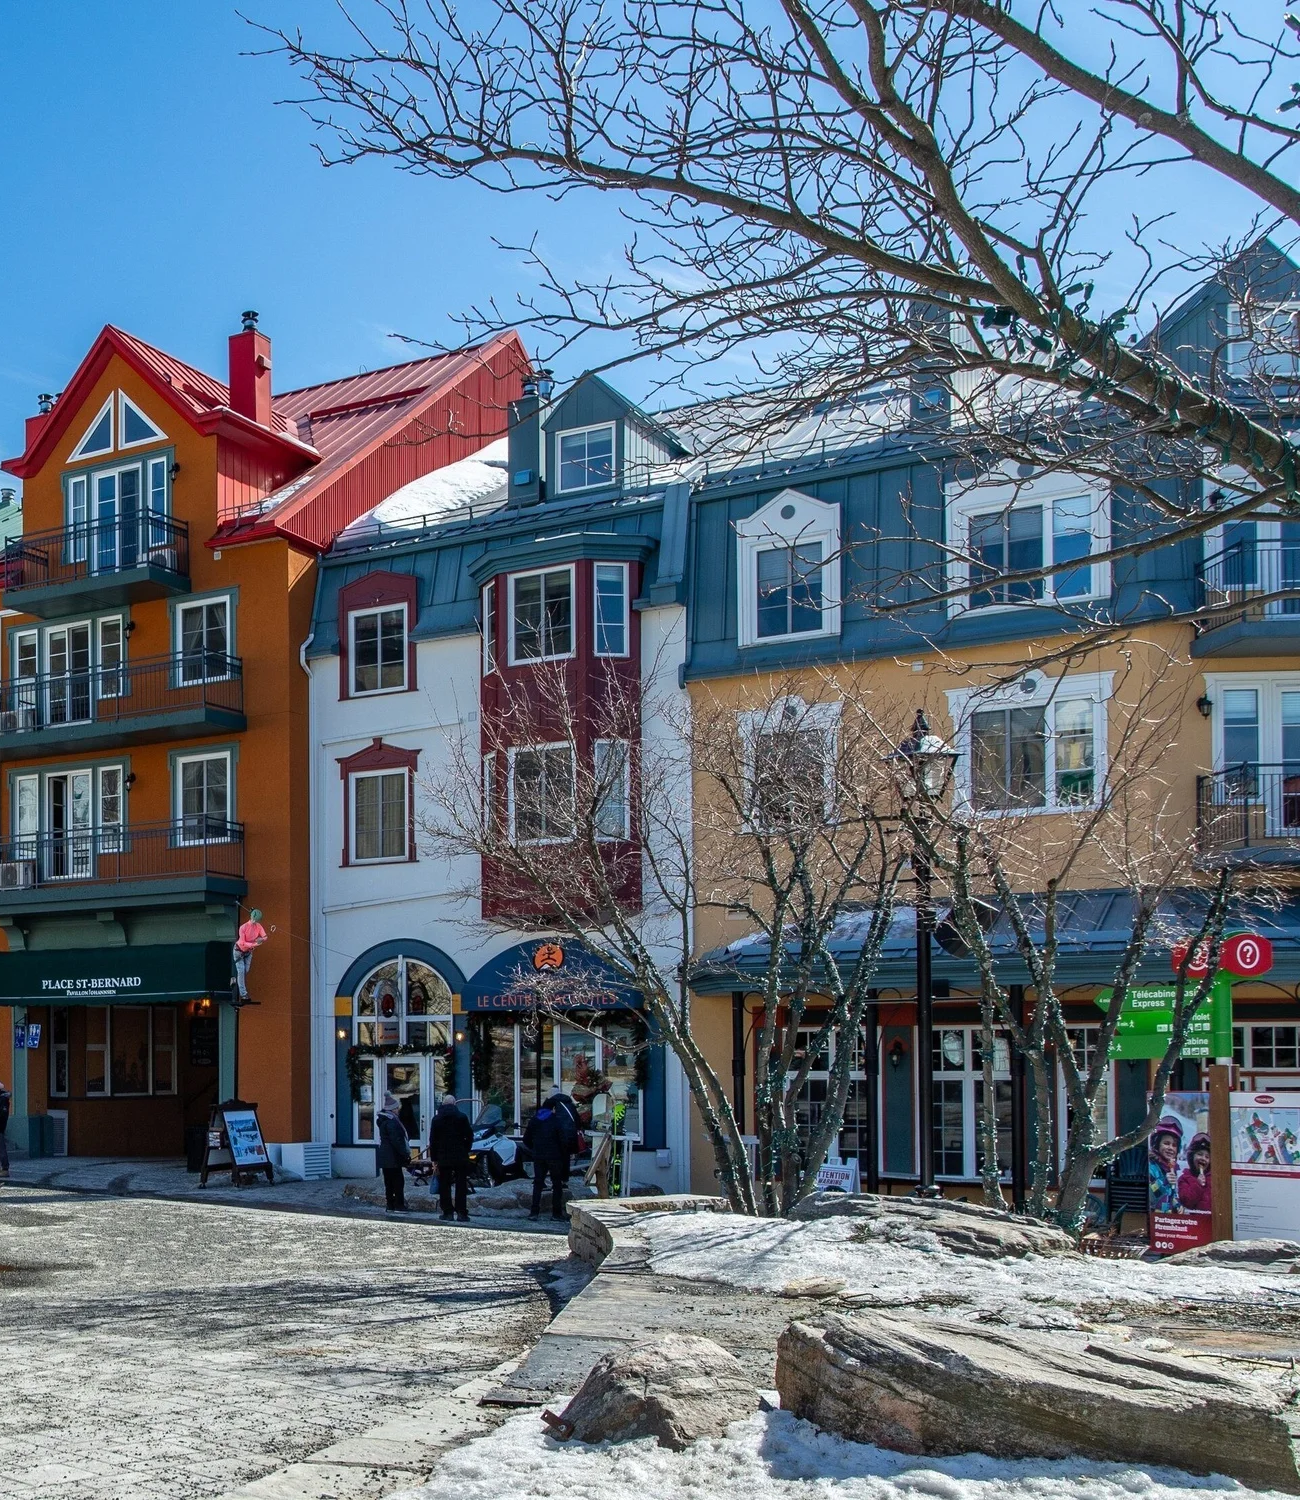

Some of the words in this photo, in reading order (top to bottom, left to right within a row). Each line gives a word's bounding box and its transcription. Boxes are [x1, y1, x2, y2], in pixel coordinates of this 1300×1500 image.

[42, 979, 74, 990] PLACE
[76, 977, 141, 989] ST-BERNARD
[1132, 990, 1175, 999] Télécabine
[477, 995, 490, 1007] LE
[492, 994, 537, 1007] CENTR
[1132, 999, 1165, 1008] Express
[818, 1171, 850, 1180] TTENTION
[1154, 1216, 1181, 1225] Partagez
